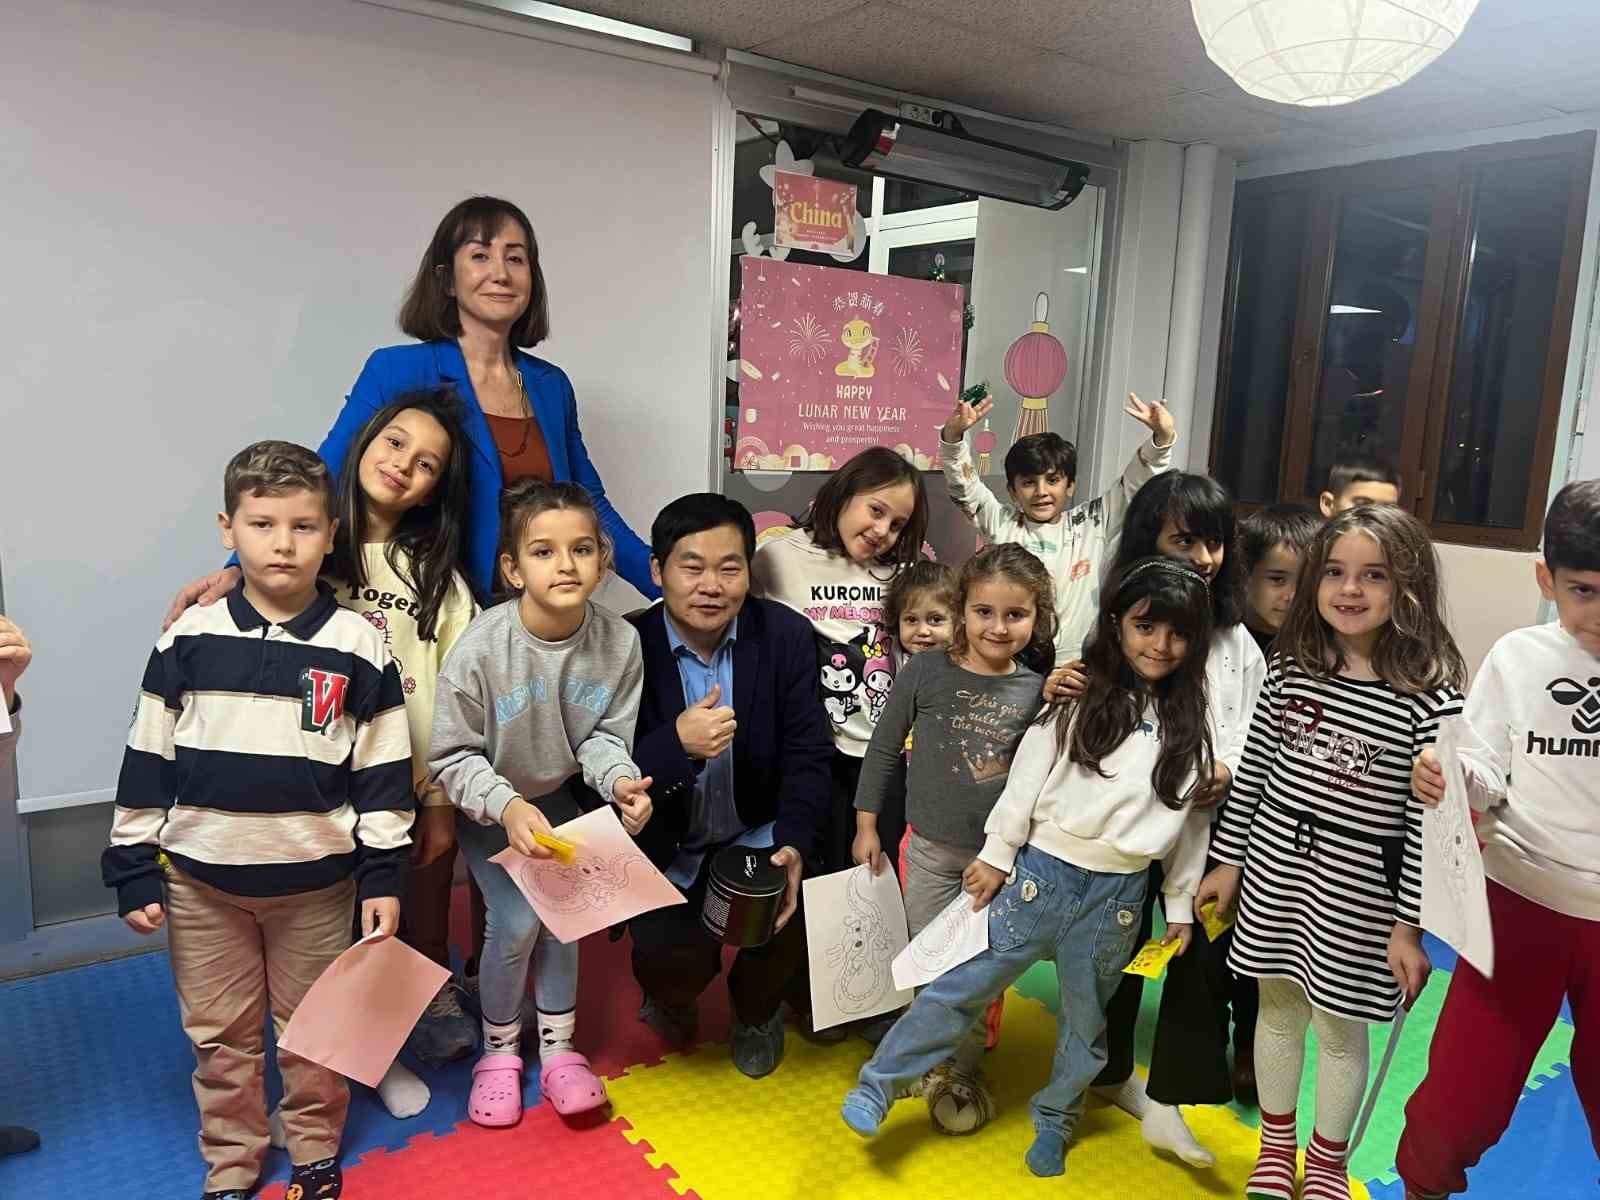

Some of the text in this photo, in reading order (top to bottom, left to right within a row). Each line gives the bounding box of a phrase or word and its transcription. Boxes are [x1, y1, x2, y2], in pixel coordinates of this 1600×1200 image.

[790, 201, 843, 228] China
[836, 384, 873, 400] HAPPY
[798, 403, 907, 422] LUNAR NEW YEAR
[802, 422, 900, 433] Wishing you great happiness
[826, 436, 839, 444] and
[810, 585, 881, 601] KUROMI
[346, 583, 428, 630] Toget
